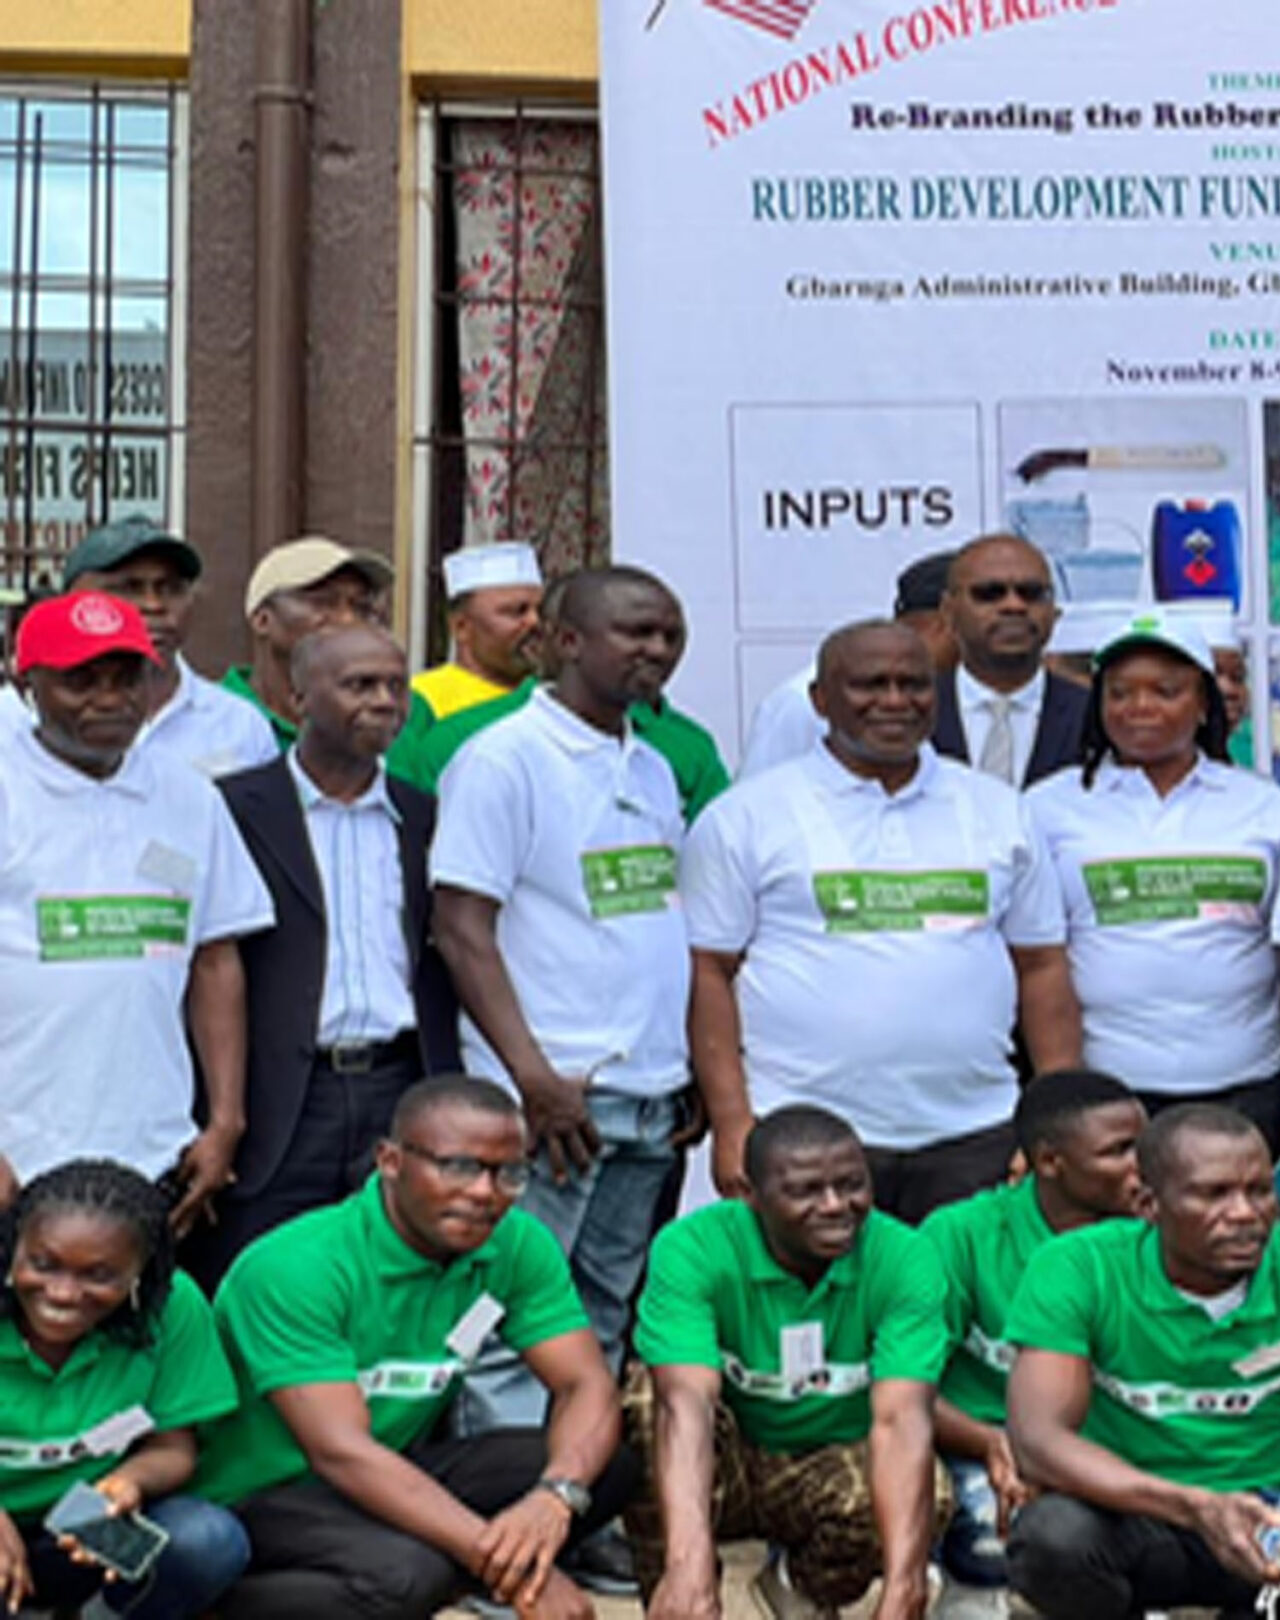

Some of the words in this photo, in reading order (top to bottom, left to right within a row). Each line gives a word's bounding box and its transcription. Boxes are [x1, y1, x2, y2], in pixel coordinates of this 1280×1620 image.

[702, 31, 880, 148] NATIONAL
[883, 0, 1120, 61] CONFERE
[850, 102, 1074, 133] Re-Branding
[1084, 102, 1142, 129] the
[751, 175, 901, 222] RUBBER
[911, 174, 1190, 220] DEVELOPMENT
[785, 275, 905, 303] Gbarnga
[913, 274, 1111, 298] Administrative
[1120, 273, 1241, 300] Building,
[1208, 329, 1279, 350] DATE
[1106, 359, 1242, 383] November
[763, 486, 954, 530] INPUTS
